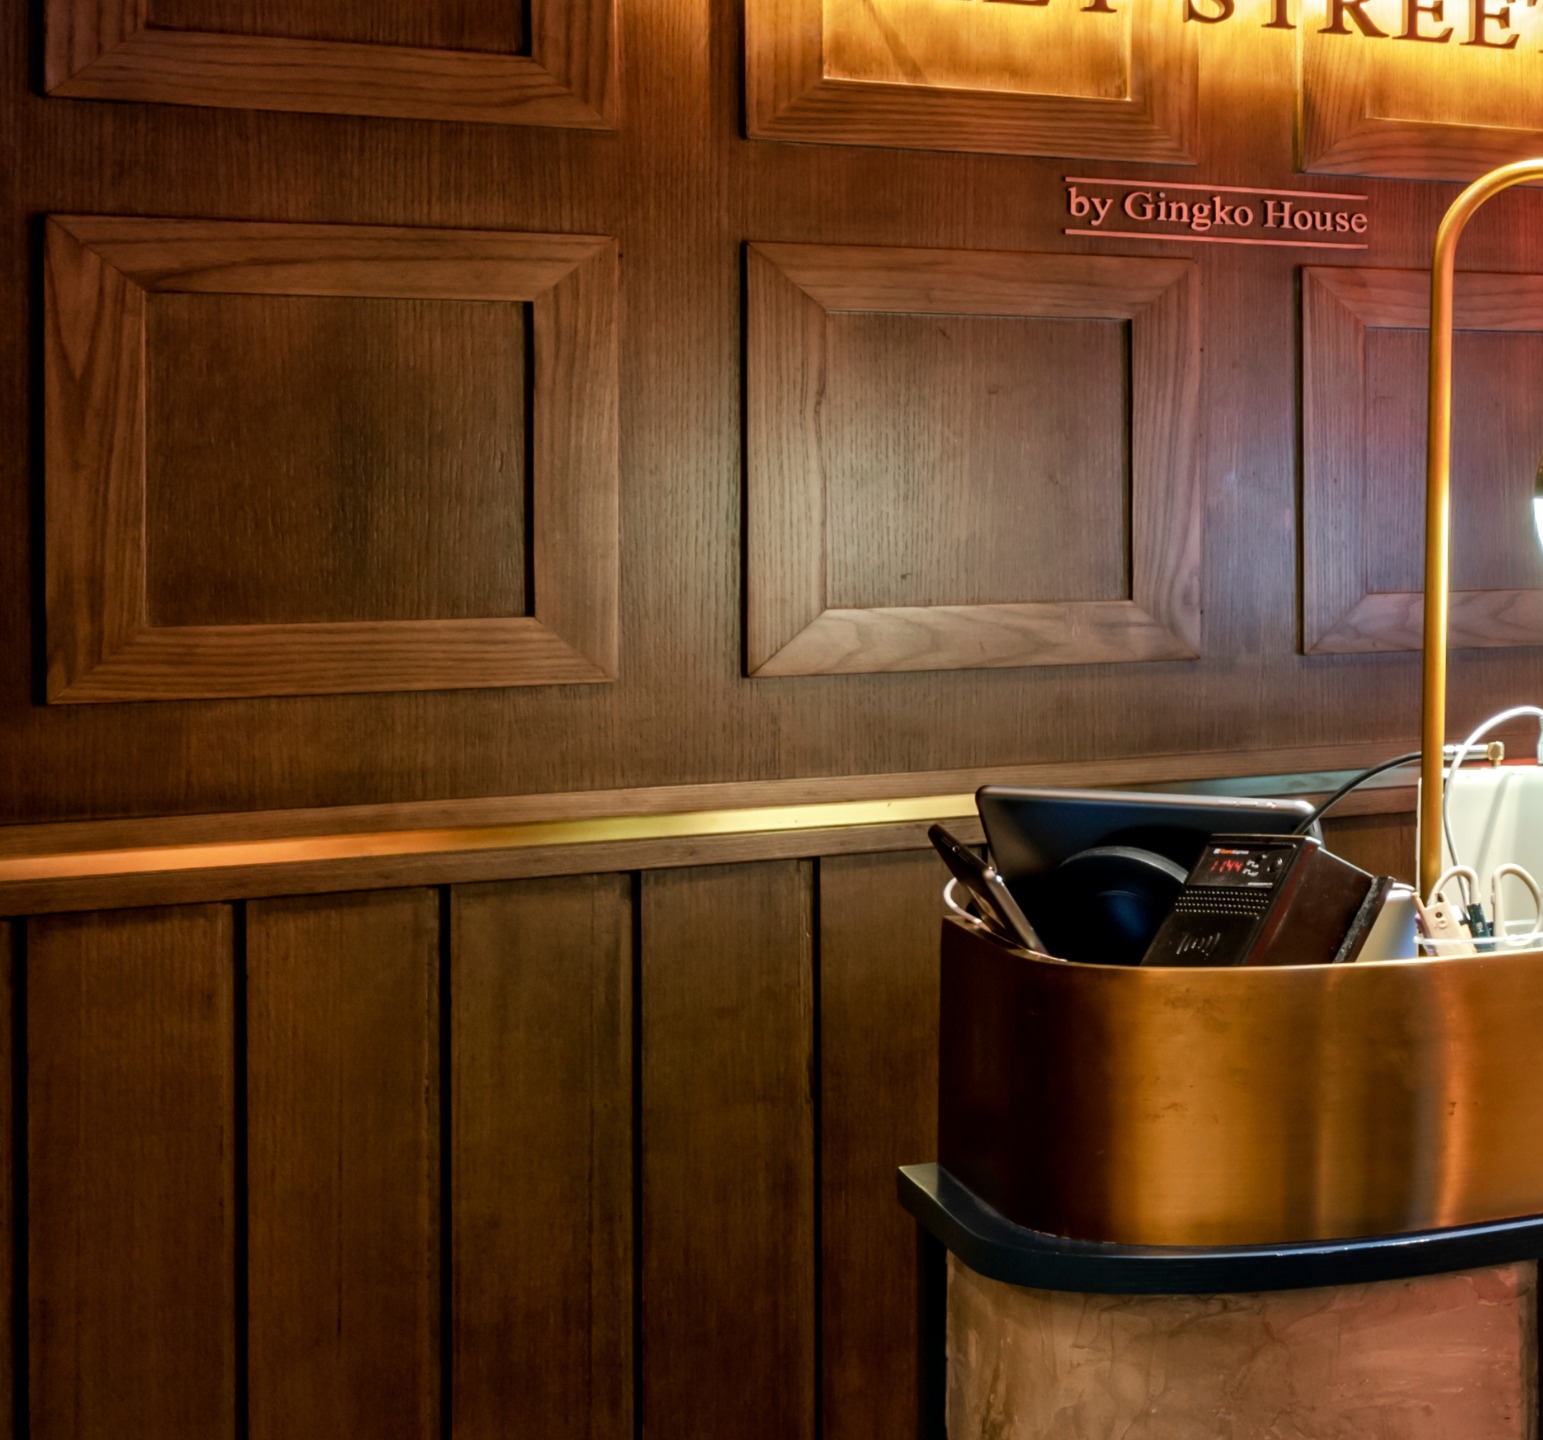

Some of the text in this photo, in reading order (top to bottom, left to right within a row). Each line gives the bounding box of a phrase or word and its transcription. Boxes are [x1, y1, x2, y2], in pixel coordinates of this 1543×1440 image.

[1068, 187, 1368, 233] by Gingko House
